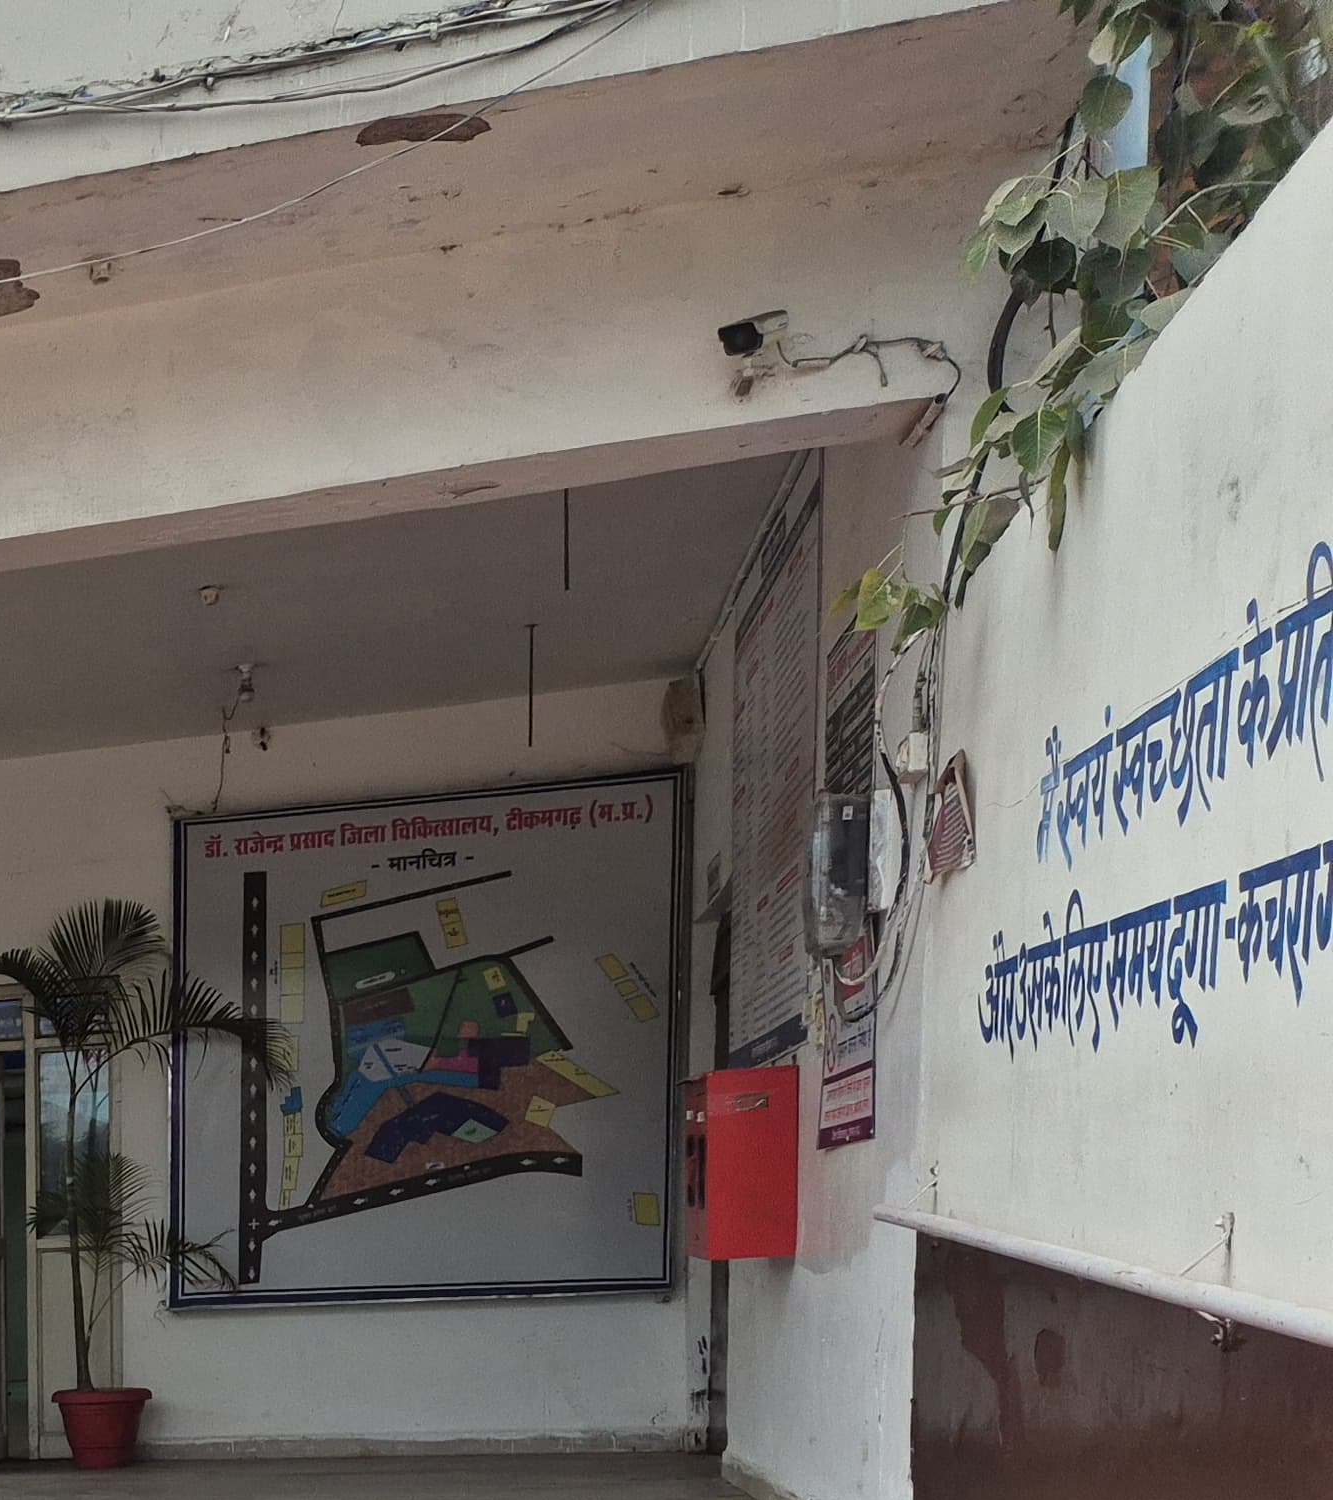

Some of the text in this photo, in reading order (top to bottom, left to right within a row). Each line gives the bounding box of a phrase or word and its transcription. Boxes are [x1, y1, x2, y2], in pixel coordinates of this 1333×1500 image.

[1056, 704, 1114, 872] स्वयं
[1112, 646, 1240, 828] स्वच्छता
[1237, 597, 1273, 769] के
[235, 831, 286, 857] राजेन्द्र
[289, 829, 337, 852] प्रसाद
[340, 822, 387, 847] जिला
[387, 848, 458, 873] मानचित्र
[1061, 888, 1109, 1053] लिए
[1105, 898, 1172, 1033] समय
